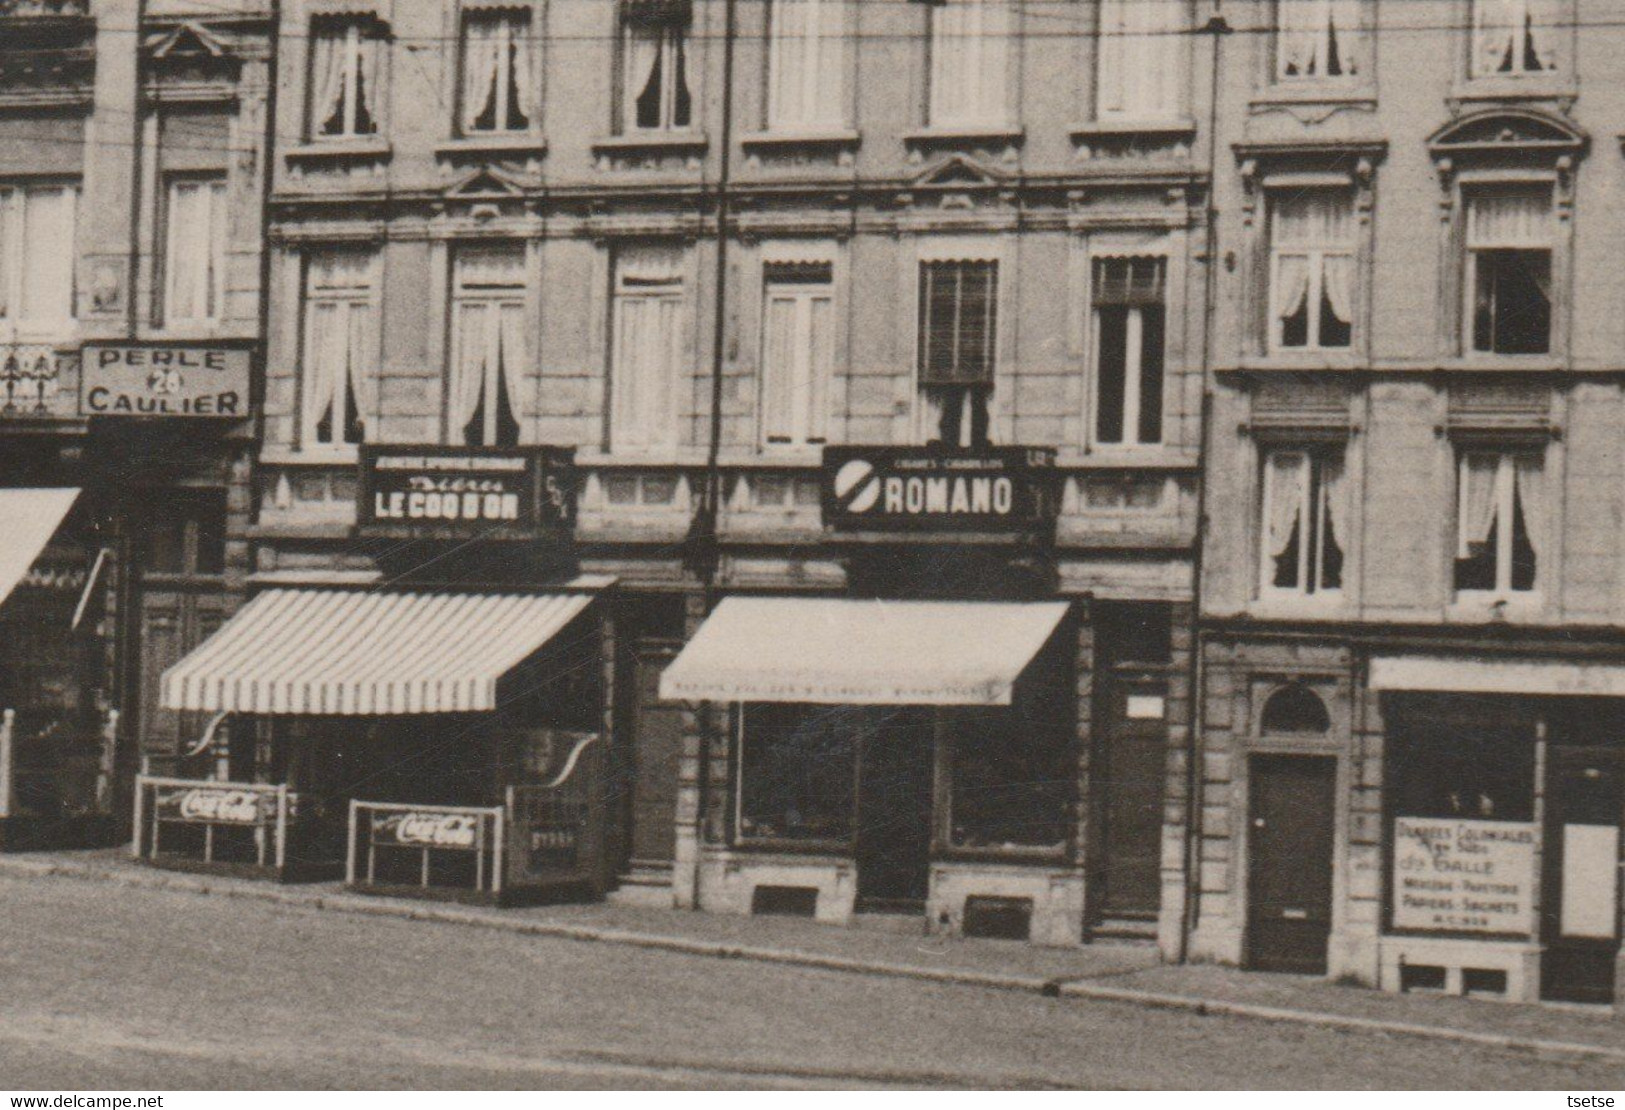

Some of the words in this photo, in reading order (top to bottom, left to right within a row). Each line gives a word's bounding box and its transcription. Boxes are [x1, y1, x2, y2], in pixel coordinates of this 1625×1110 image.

[99, 350, 226, 371] PERLE
[89, 386, 239, 414] CAULIER
[375, 491, 405, 518] LE
[408, 491, 460, 519] COQ
[885, 476, 1012, 514] ROMANO
